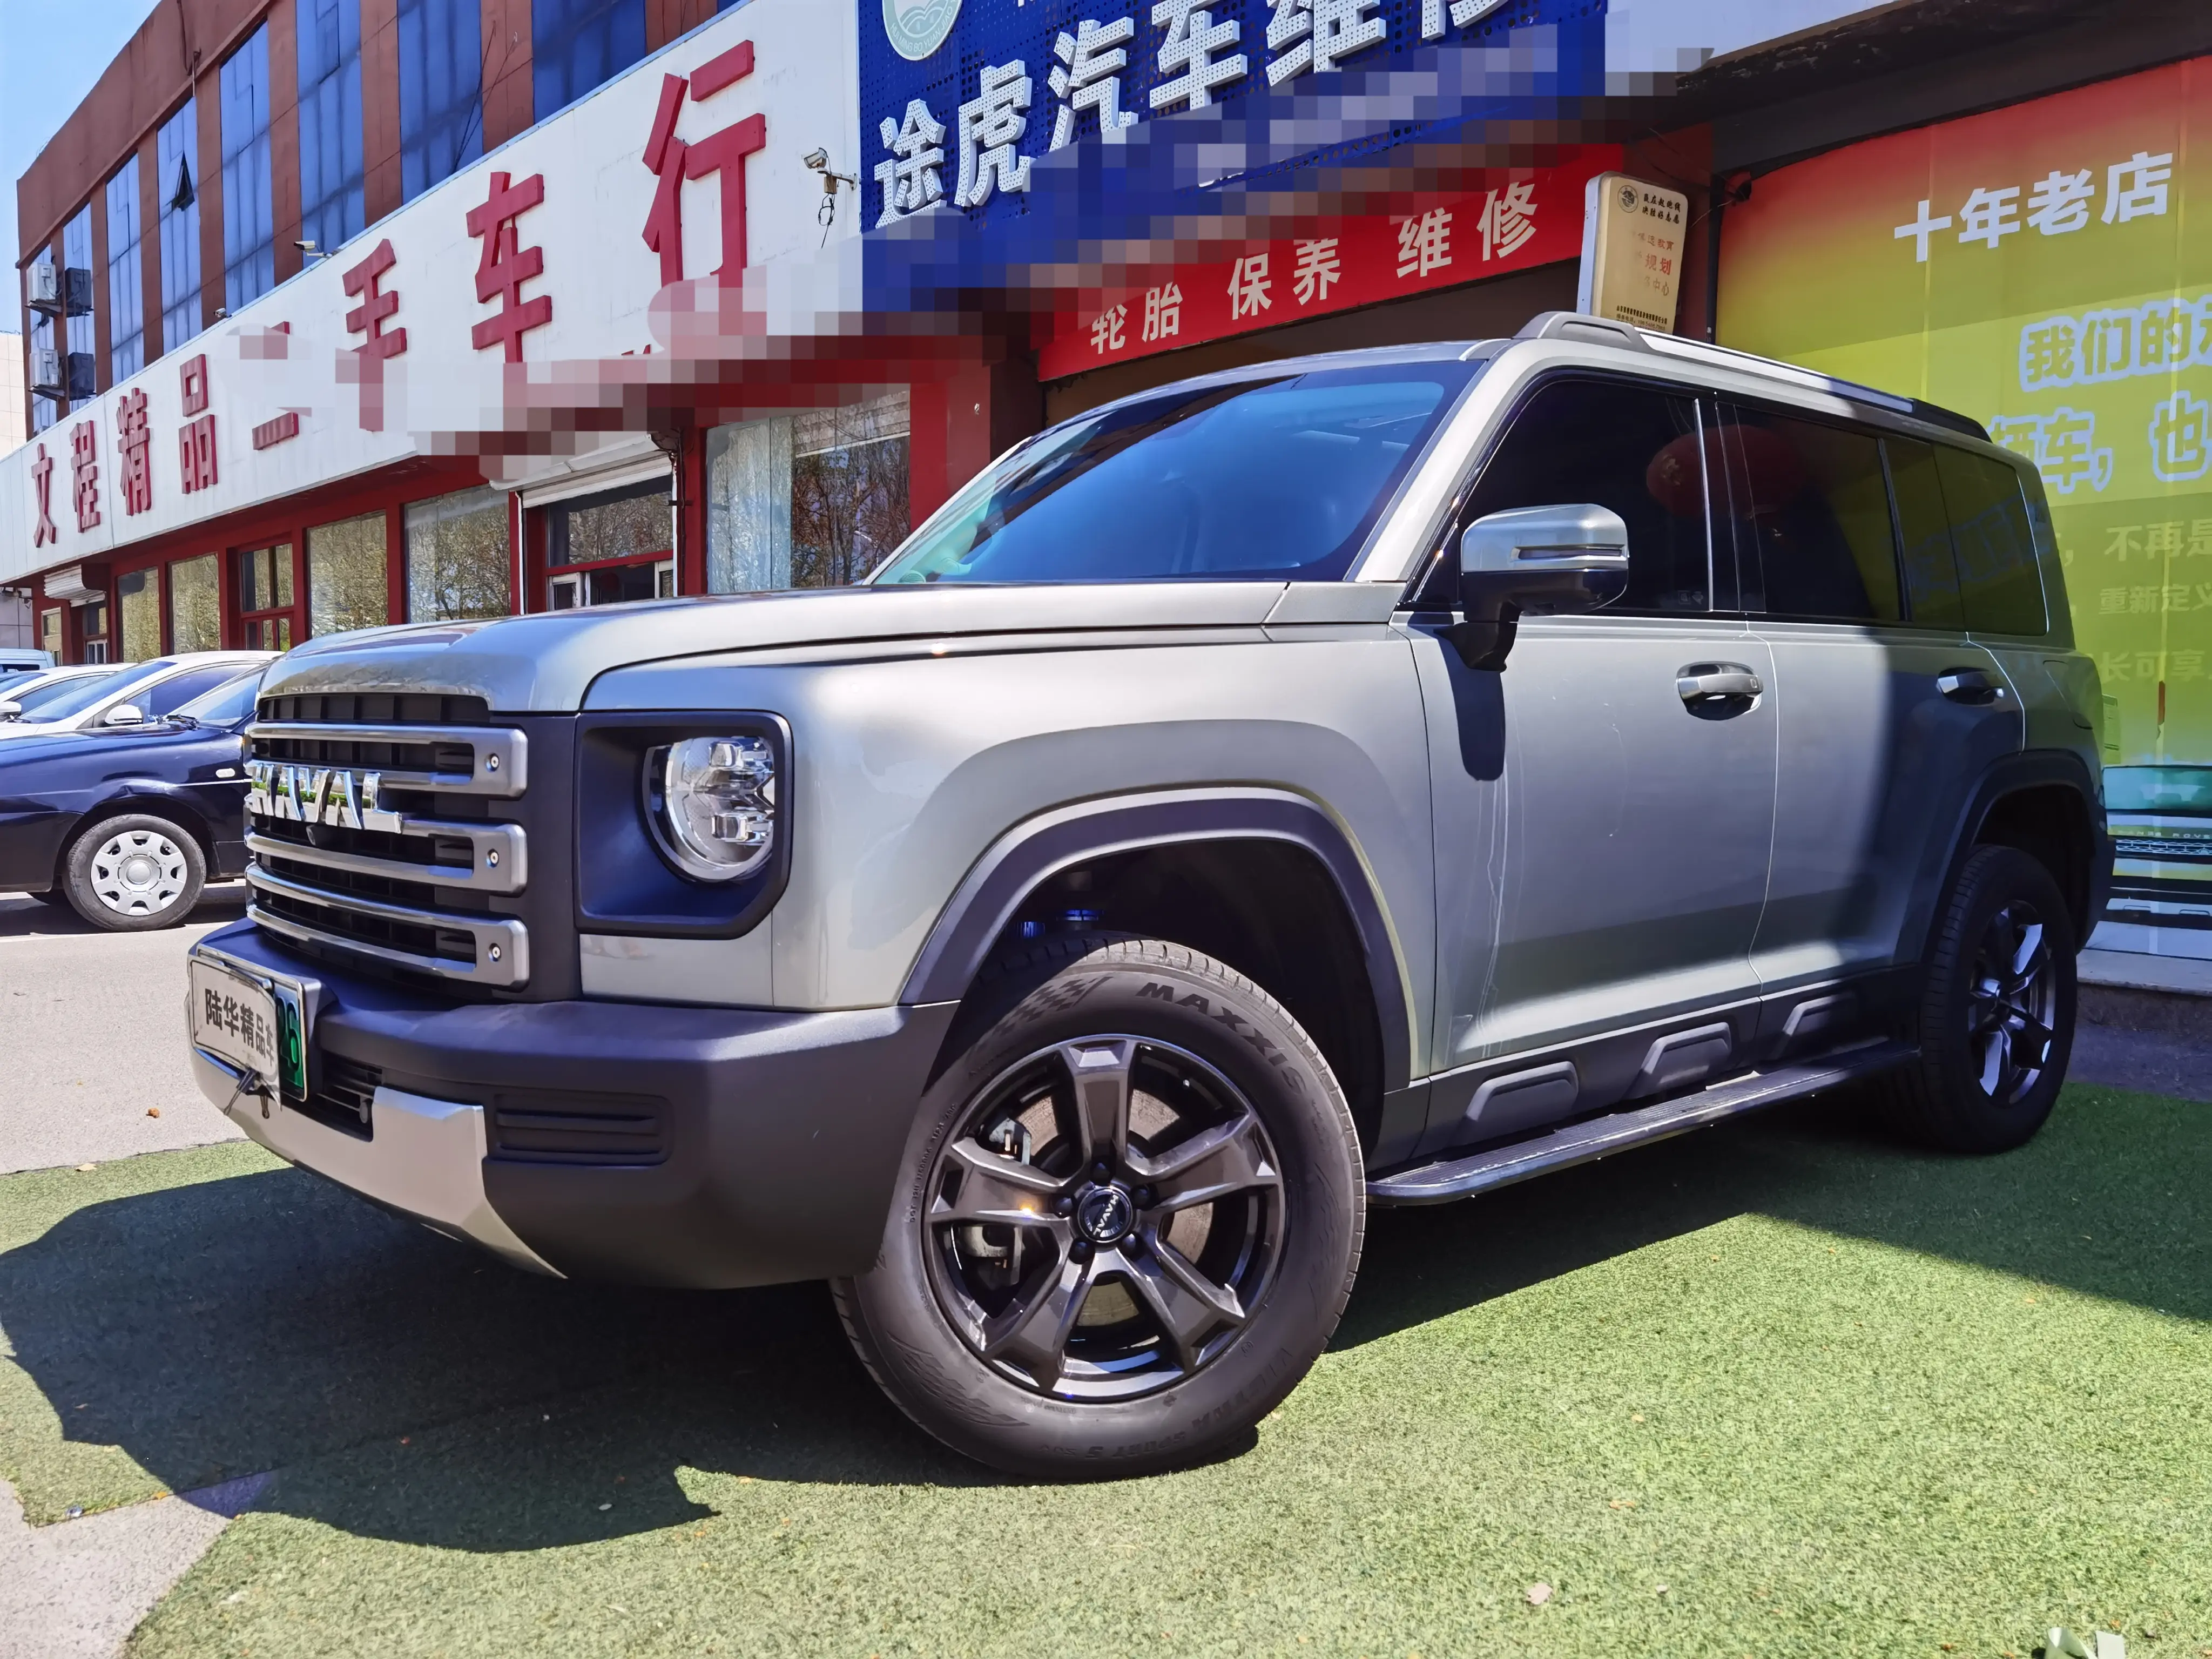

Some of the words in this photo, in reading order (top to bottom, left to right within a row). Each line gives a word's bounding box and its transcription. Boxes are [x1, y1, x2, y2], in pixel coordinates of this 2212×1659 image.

[874, 0, 1512, 229] 途虎汽车维
[1894, 151, 2173, 263] 十年老店
[1090, 282, 1183, 354] 轮胎
[1227, 238, 1340, 321] 保养
[1397, 182, 1538, 279] 维修
[2019, 294, 2212, 393] 我们的
[251, 763, 402, 833] HAVAL
[1135, 982, 1307, 1095] MAXXIS
[1093, 1194, 1118, 1236] HAVAL
